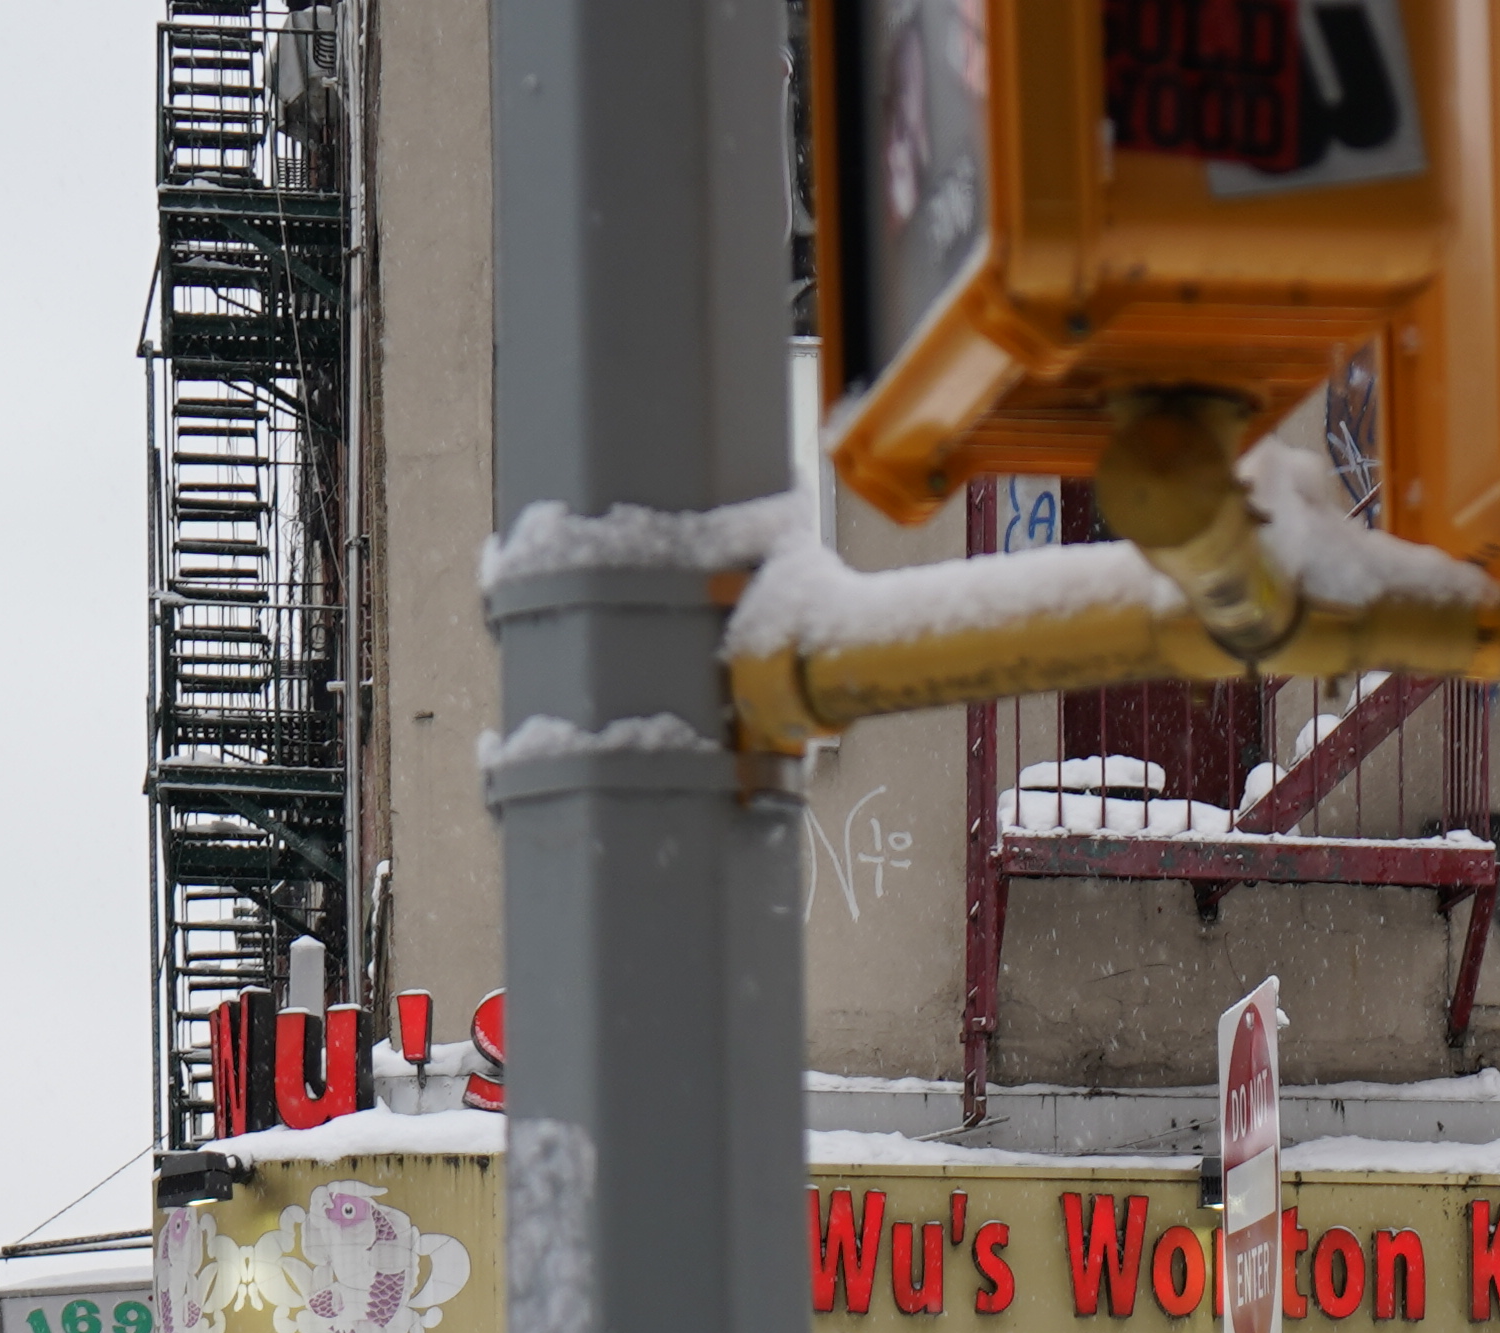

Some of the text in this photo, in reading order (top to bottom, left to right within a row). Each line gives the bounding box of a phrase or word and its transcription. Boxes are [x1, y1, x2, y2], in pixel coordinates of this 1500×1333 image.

[1231, 1069, 1269, 1142] DO NOT
[809, 1187, 1015, 1315] Wu's
[1060, 1192, 1426, 1321] Woton
[1236, 1242, 1271, 1307] ENTER
